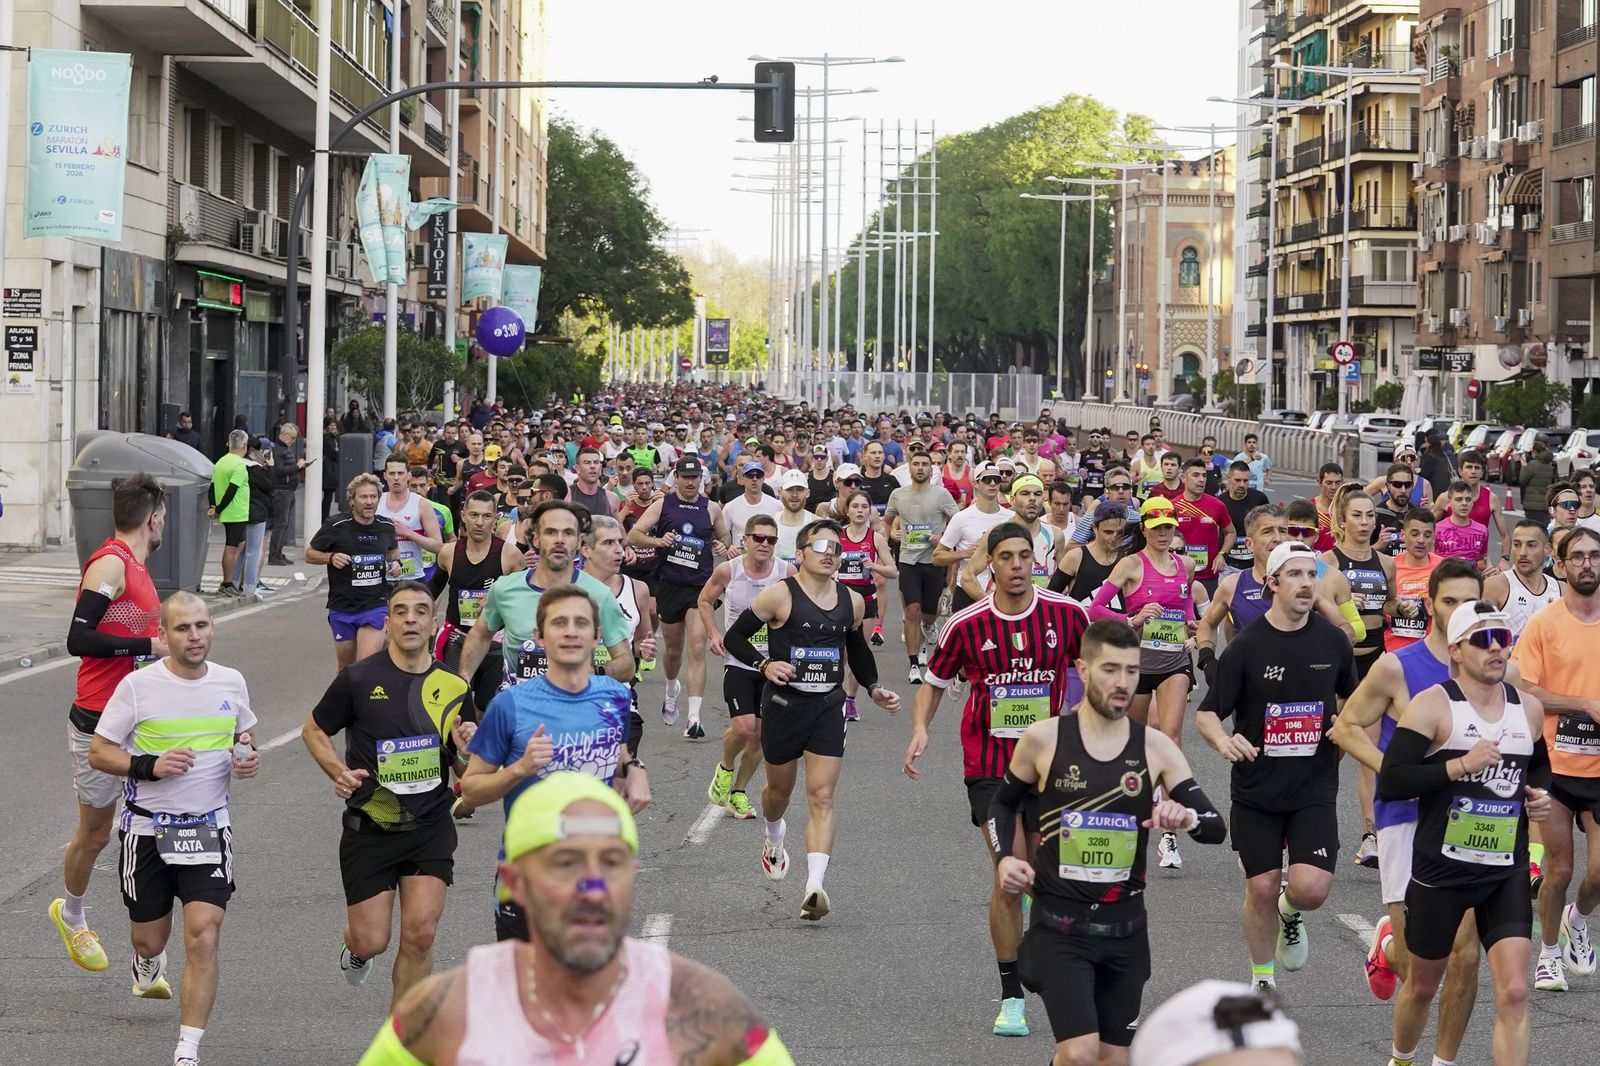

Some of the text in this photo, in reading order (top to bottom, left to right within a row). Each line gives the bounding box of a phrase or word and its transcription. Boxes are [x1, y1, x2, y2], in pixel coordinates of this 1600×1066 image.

[48, 124, 88, 134] ZURICH
[46, 144, 88, 155] SEVILLA
[63, 162, 96, 171] FEBRERO
[68, 198, 94, 206] ZURICH
[433, 211, 446, 282] ENTOFT
[502, 323, 519, 338] 3:00
[1445, 353, 1471, 361] TINTE
[682, 537, 702, 546] ZURICH
[363, 554, 382, 562] ZURICH
[674, 550, 696, 561] MARIO
[356, 570, 381, 579] CARLOS
[1161, 611, 1182, 620] ZURICH
[1394, 618, 1425, 629] VALLEJO
[1150, 631, 1179, 642] MARTA
[808, 650, 835, 658] ZURICH
[807, 663, 823, 671] 4502
[1010, 657, 1033, 670] Fly
[801, 672, 827, 682] JUAN
[984, 668, 1056, 686] Emirates
[1010, 687, 1043, 696] ZURICH
[1011, 704, 1030, 712] 2394
[1284, 704, 1316, 714] ZURICH
[1004, 714, 1037, 726] ROMS
[1285, 720, 1303, 730] 1046
[1577, 723, 1595, 732] 4018
[546, 725, 625, 749] UNNERS
[1264, 731, 1322, 744] JACK RYAN
[1555, 734, 1581, 745] BENOIT
[398, 737, 433, 750] ZURICH
[401, 756, 420, 767] 2457
[379, 766, 441, 784] MARTINATOR
[1062, 779, 1088, 790] Trigal
[1495, 783, 1512, 793] fresh
[1477, 803, 1513, 814] ZURICH
[174, 814, 209, 825] ZURICH
[1087, 816, 1129, 828] ZURICH
[177, 828, 198, 838] 4008
[1474, 822, 1496, 833] 3348
[173, 839, 205, 853] KATA
[1087, 837, 1110, 847] 3280
[1463, 834, 1500, 850] JUAN
[1081, 850, 1114, 866] DITO
